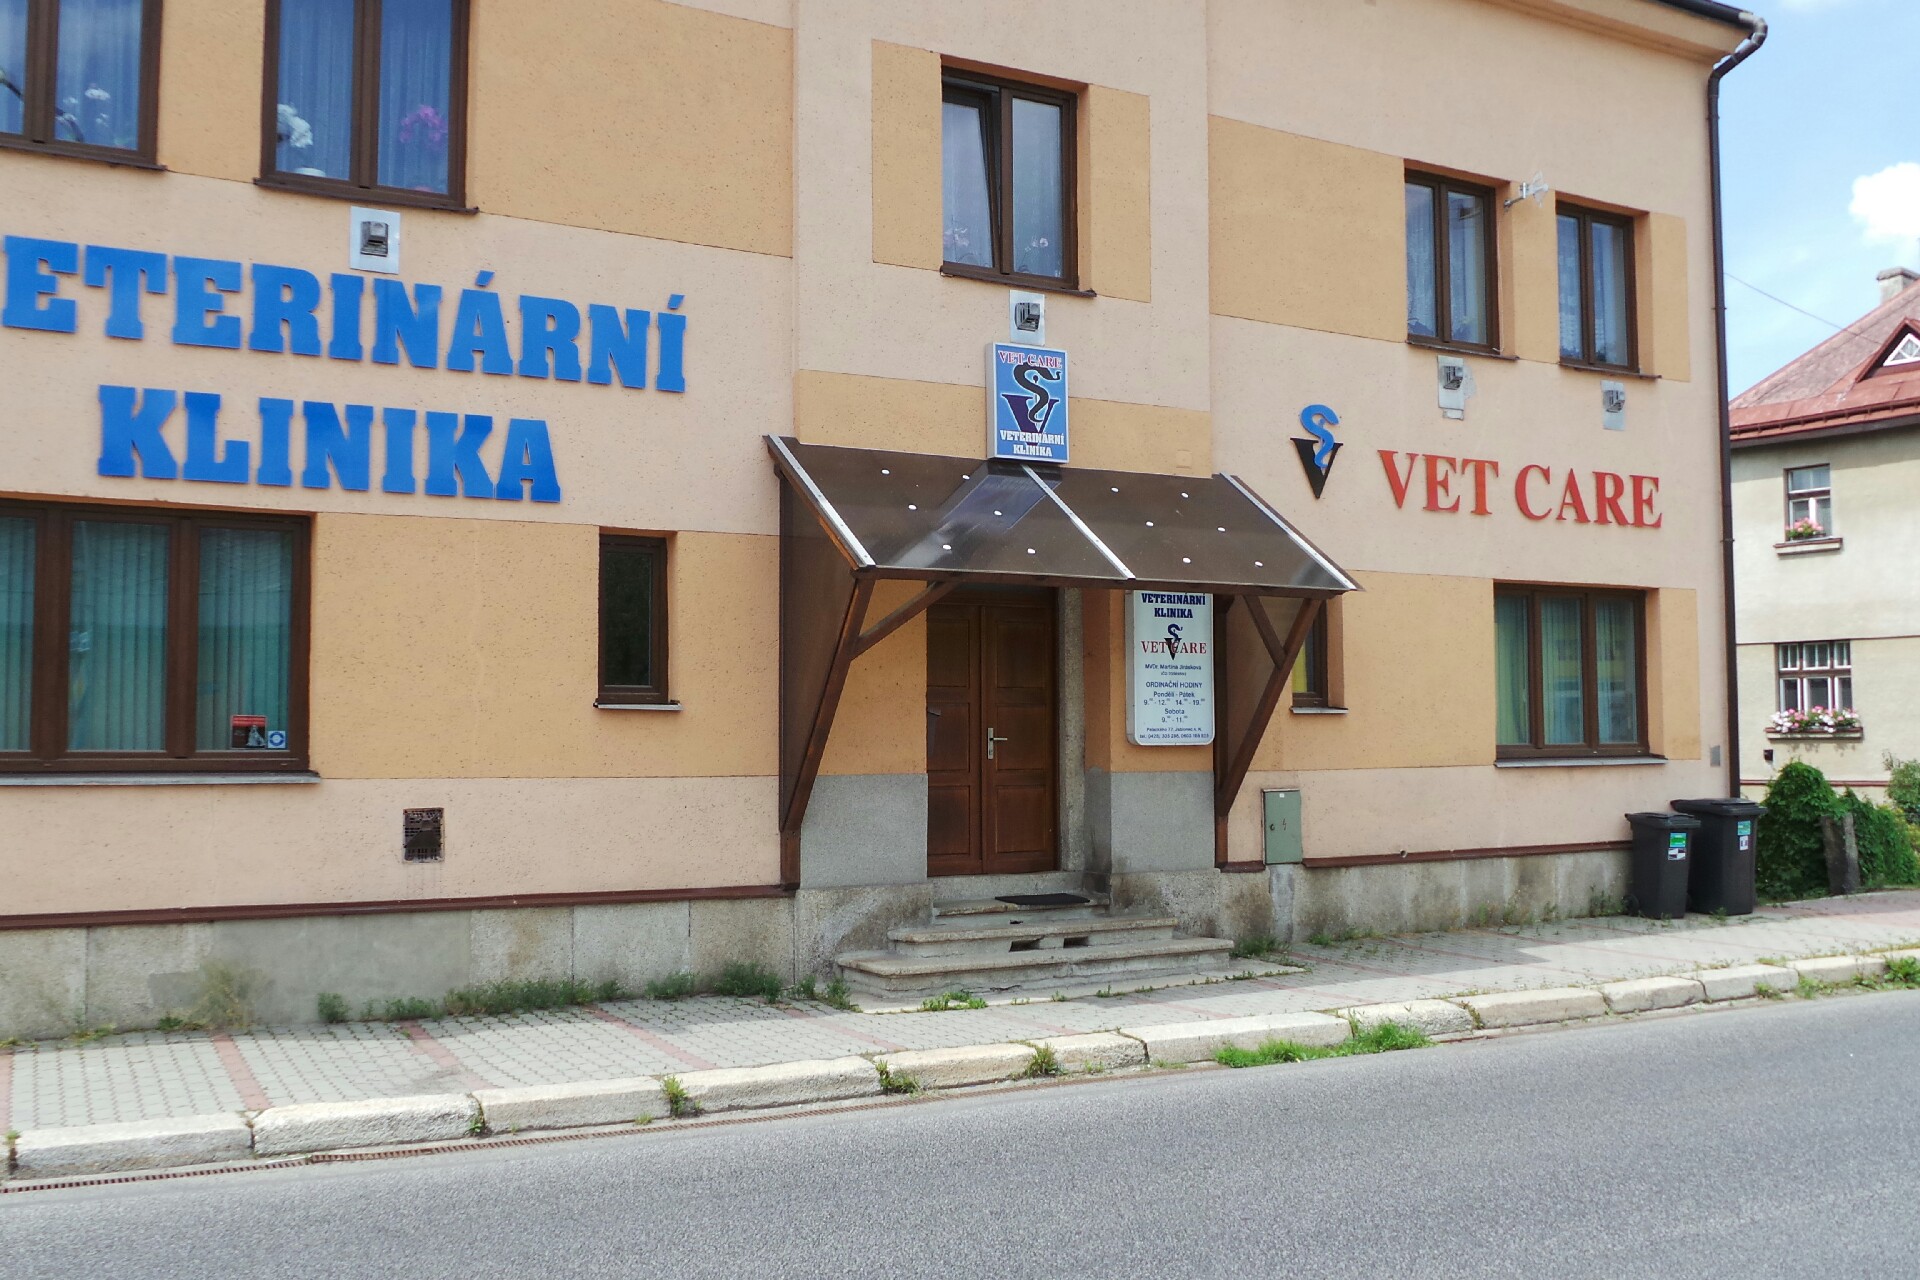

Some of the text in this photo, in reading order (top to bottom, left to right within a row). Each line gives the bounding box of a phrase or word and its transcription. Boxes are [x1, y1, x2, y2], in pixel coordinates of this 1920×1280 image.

[998, 350, 1062, 369] VET CARE
[97, 384, 561, 503] KLINIKA
[1000, 429, 1065, 445] VETERINÁRNÍ
[1013, 444, 1053, 457] KLINIKA
[1377, 449, 1663, 529] VET CARE
[1141, 592, 1206, 606] VETERINÁRNÍ
[1154, 607, 1193, 619] KLINIKA
[1141, 640, 1167, 654] VET
[1145, 680, 1179, 688] ORDINAČNÍ
